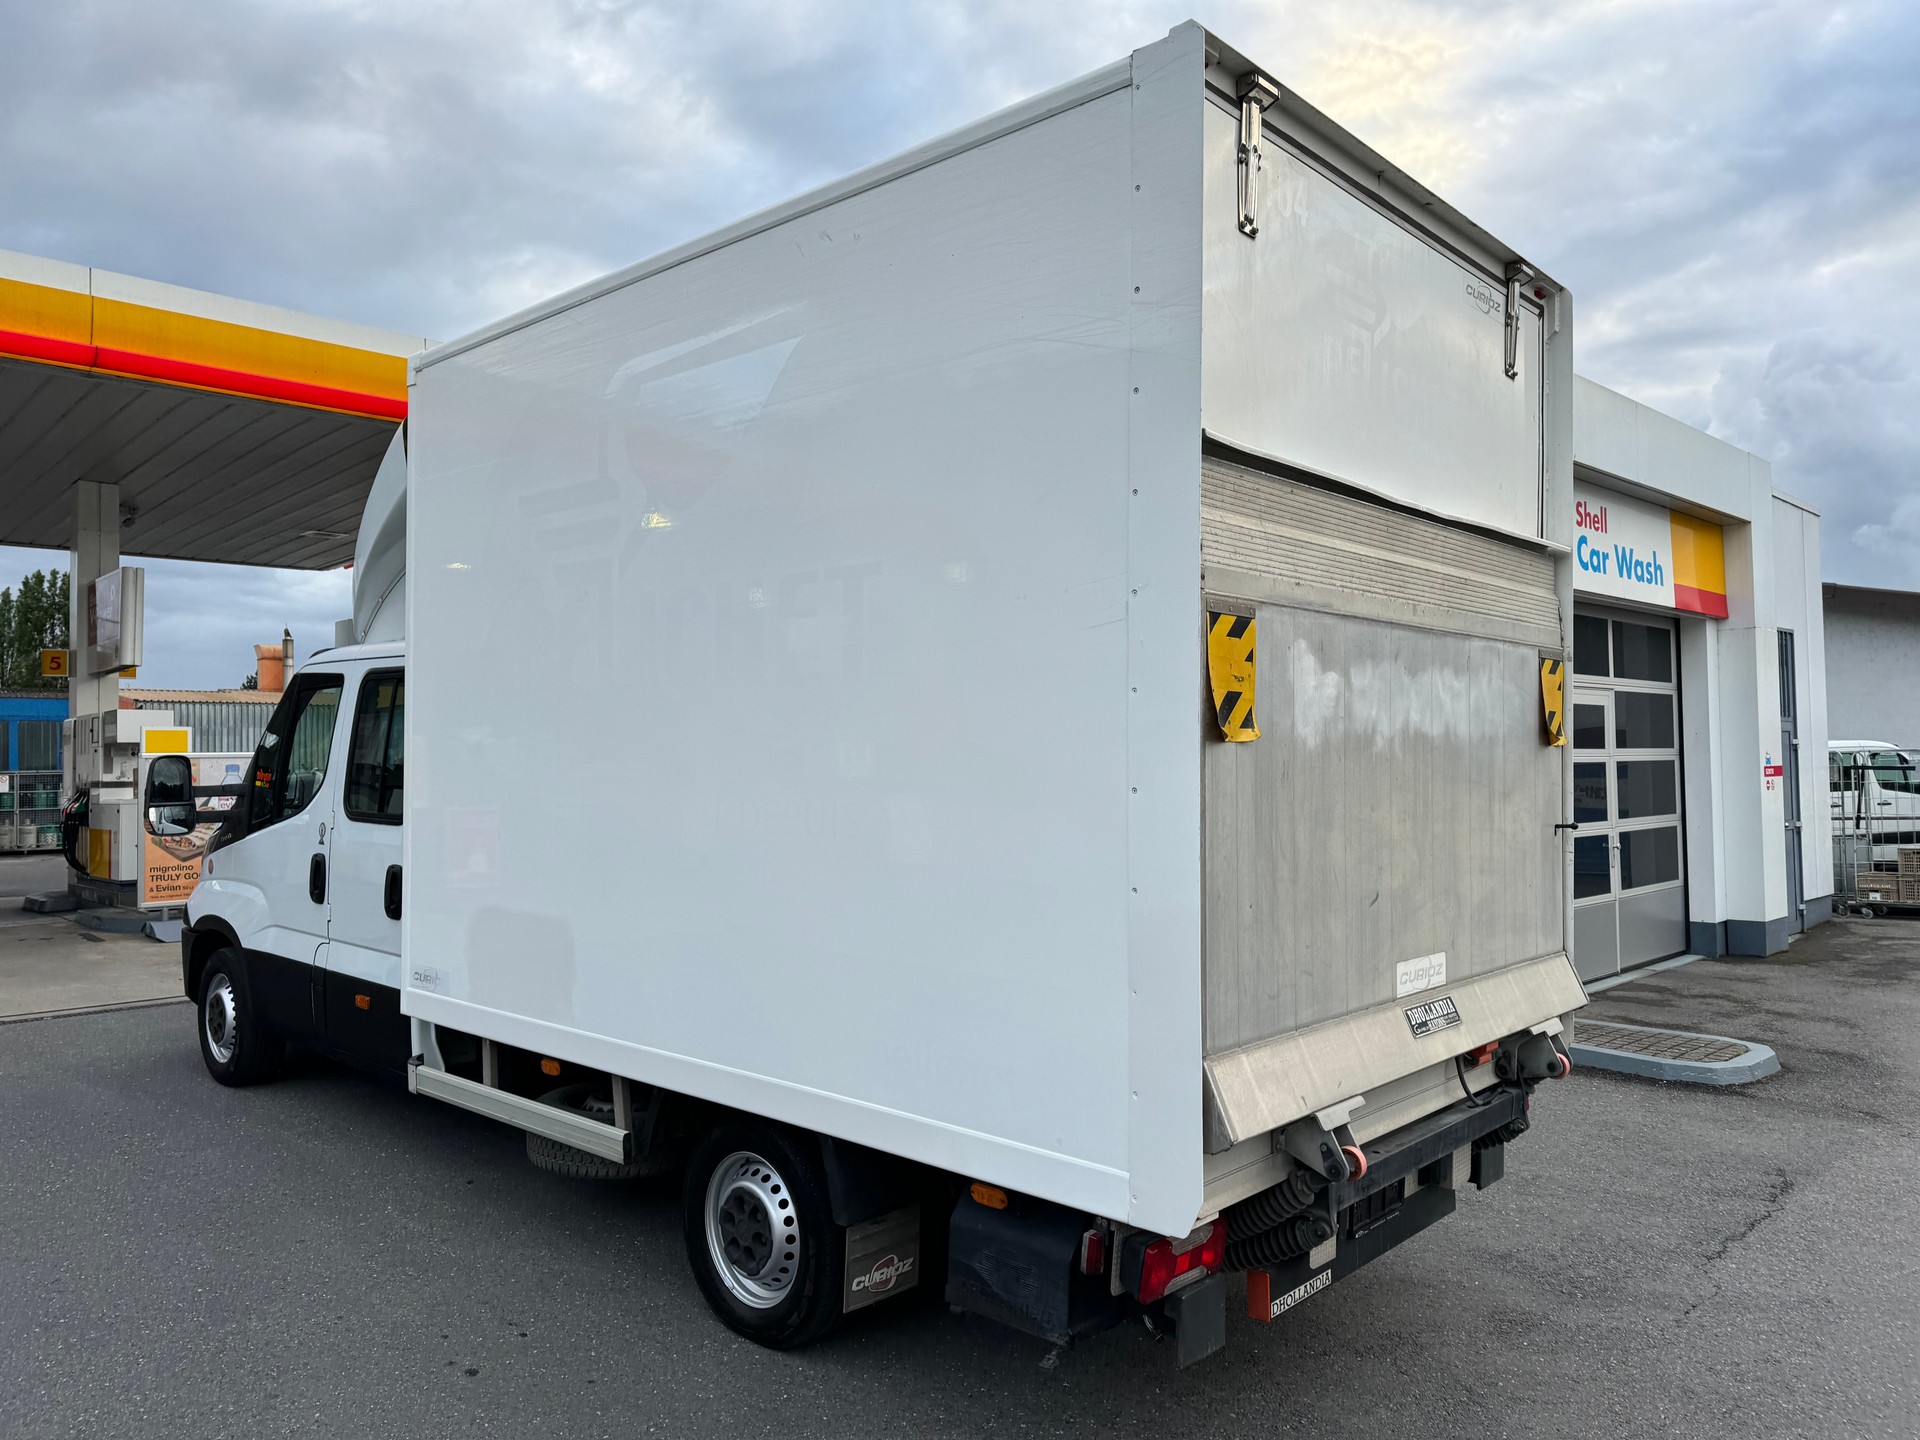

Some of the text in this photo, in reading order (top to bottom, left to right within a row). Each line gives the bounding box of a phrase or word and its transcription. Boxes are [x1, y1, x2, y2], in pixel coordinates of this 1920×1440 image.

[1575, 501, 1607, 534] Shell
[1577, 534, 1664, 587] Car Wash
[49, 656, 62, 670] 5
[149, 864, 194, 874] migrolino
[149, 872, 202, 882] TRULY GO
[155, 884, 181, 893] Evian
[1406, 998, 1456, 1026] DHOLLANDIA
[1271, 1271, 1331, 1317] DHOLLANDIA
